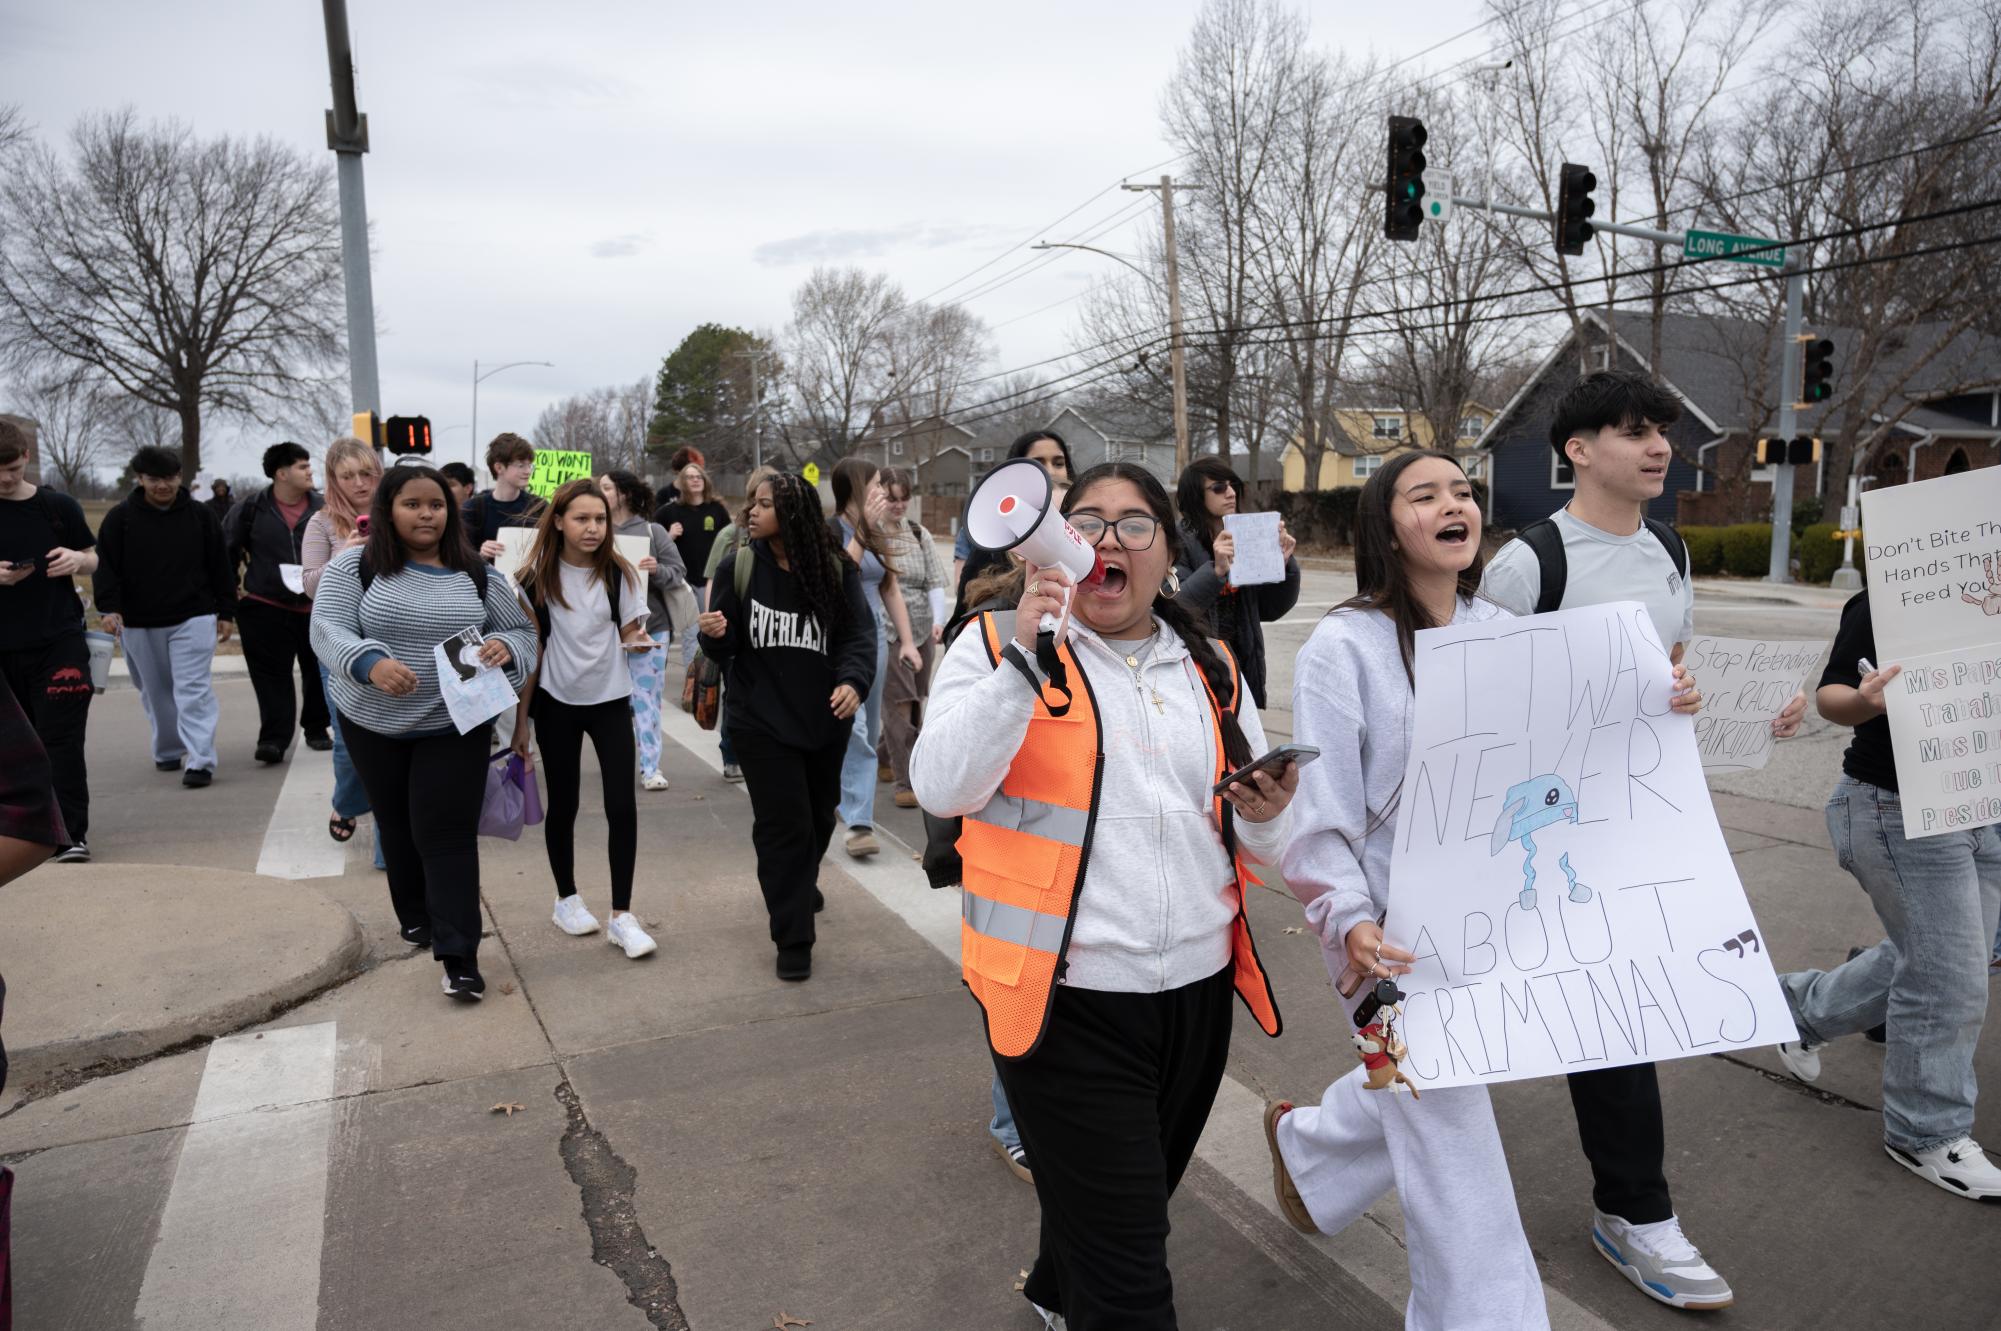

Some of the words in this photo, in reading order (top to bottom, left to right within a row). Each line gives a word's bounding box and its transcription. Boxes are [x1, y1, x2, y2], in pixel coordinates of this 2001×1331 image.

[1688, 237, 1725, 255] LONG
[1731, 242, 1782, 261] AVENUE
[408, 424, 431, 447] 11
[536, 451, 554, 467] YOU
[546, 468, 583, 485] LIK
[1868, 537, 1925, 561] Don't
[1930, 529, 1970, 549] Bite
[1884, 559, 1950, 583] Hands
[1901, 585, 1951, 607] Feed
[1687, 639, 1743, 678] Stop
[1744, 642, 1820, 676] Pretending
[1904, 668, 1948, 694] Mis
[1919, 736, 1968, 763] Mas
[1973, 730, 2001, 754] Du
[1404, 878, 1695, 982] ABOUT
